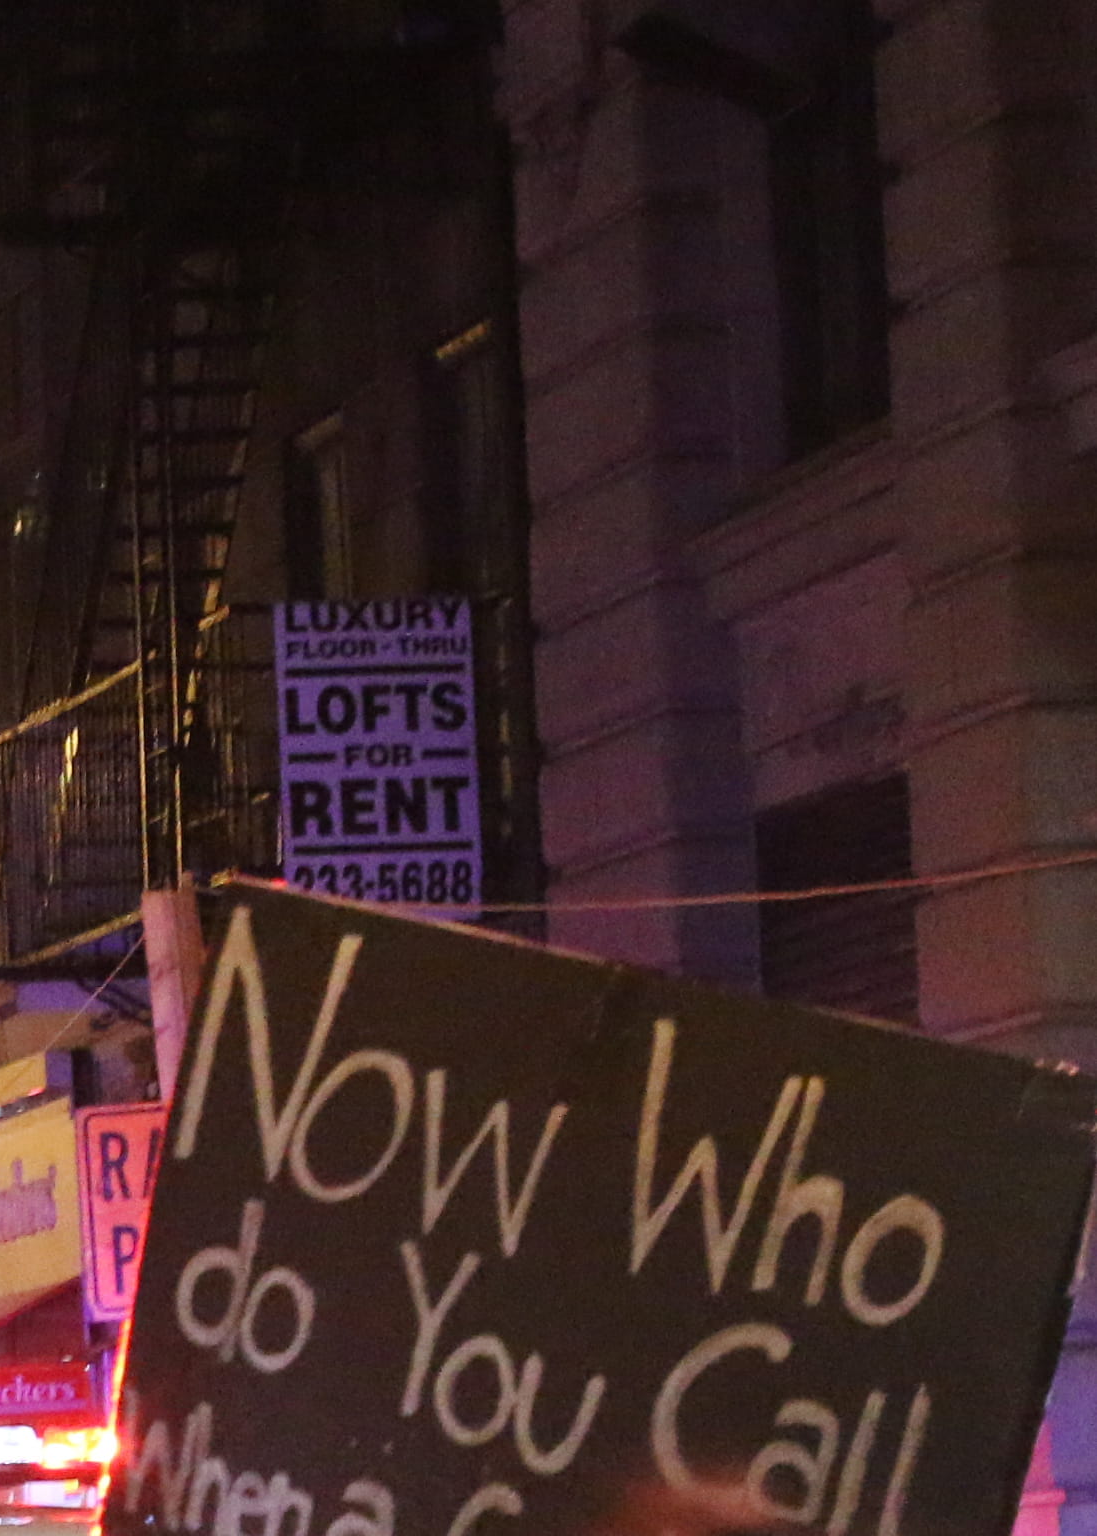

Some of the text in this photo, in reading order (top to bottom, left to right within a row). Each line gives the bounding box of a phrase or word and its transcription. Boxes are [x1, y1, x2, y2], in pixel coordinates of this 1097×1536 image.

[285, 597, 462, 633] LUXURY
[285, 682, 468, 736] LOFTS
[344, 743, 414, 768] FOR
[289, 776, 470, 838] RENT
[630, 1018, 945, 1326] Who
[174, 1199, 315, 1373] do
[401, 1239, 607, 1476] You
